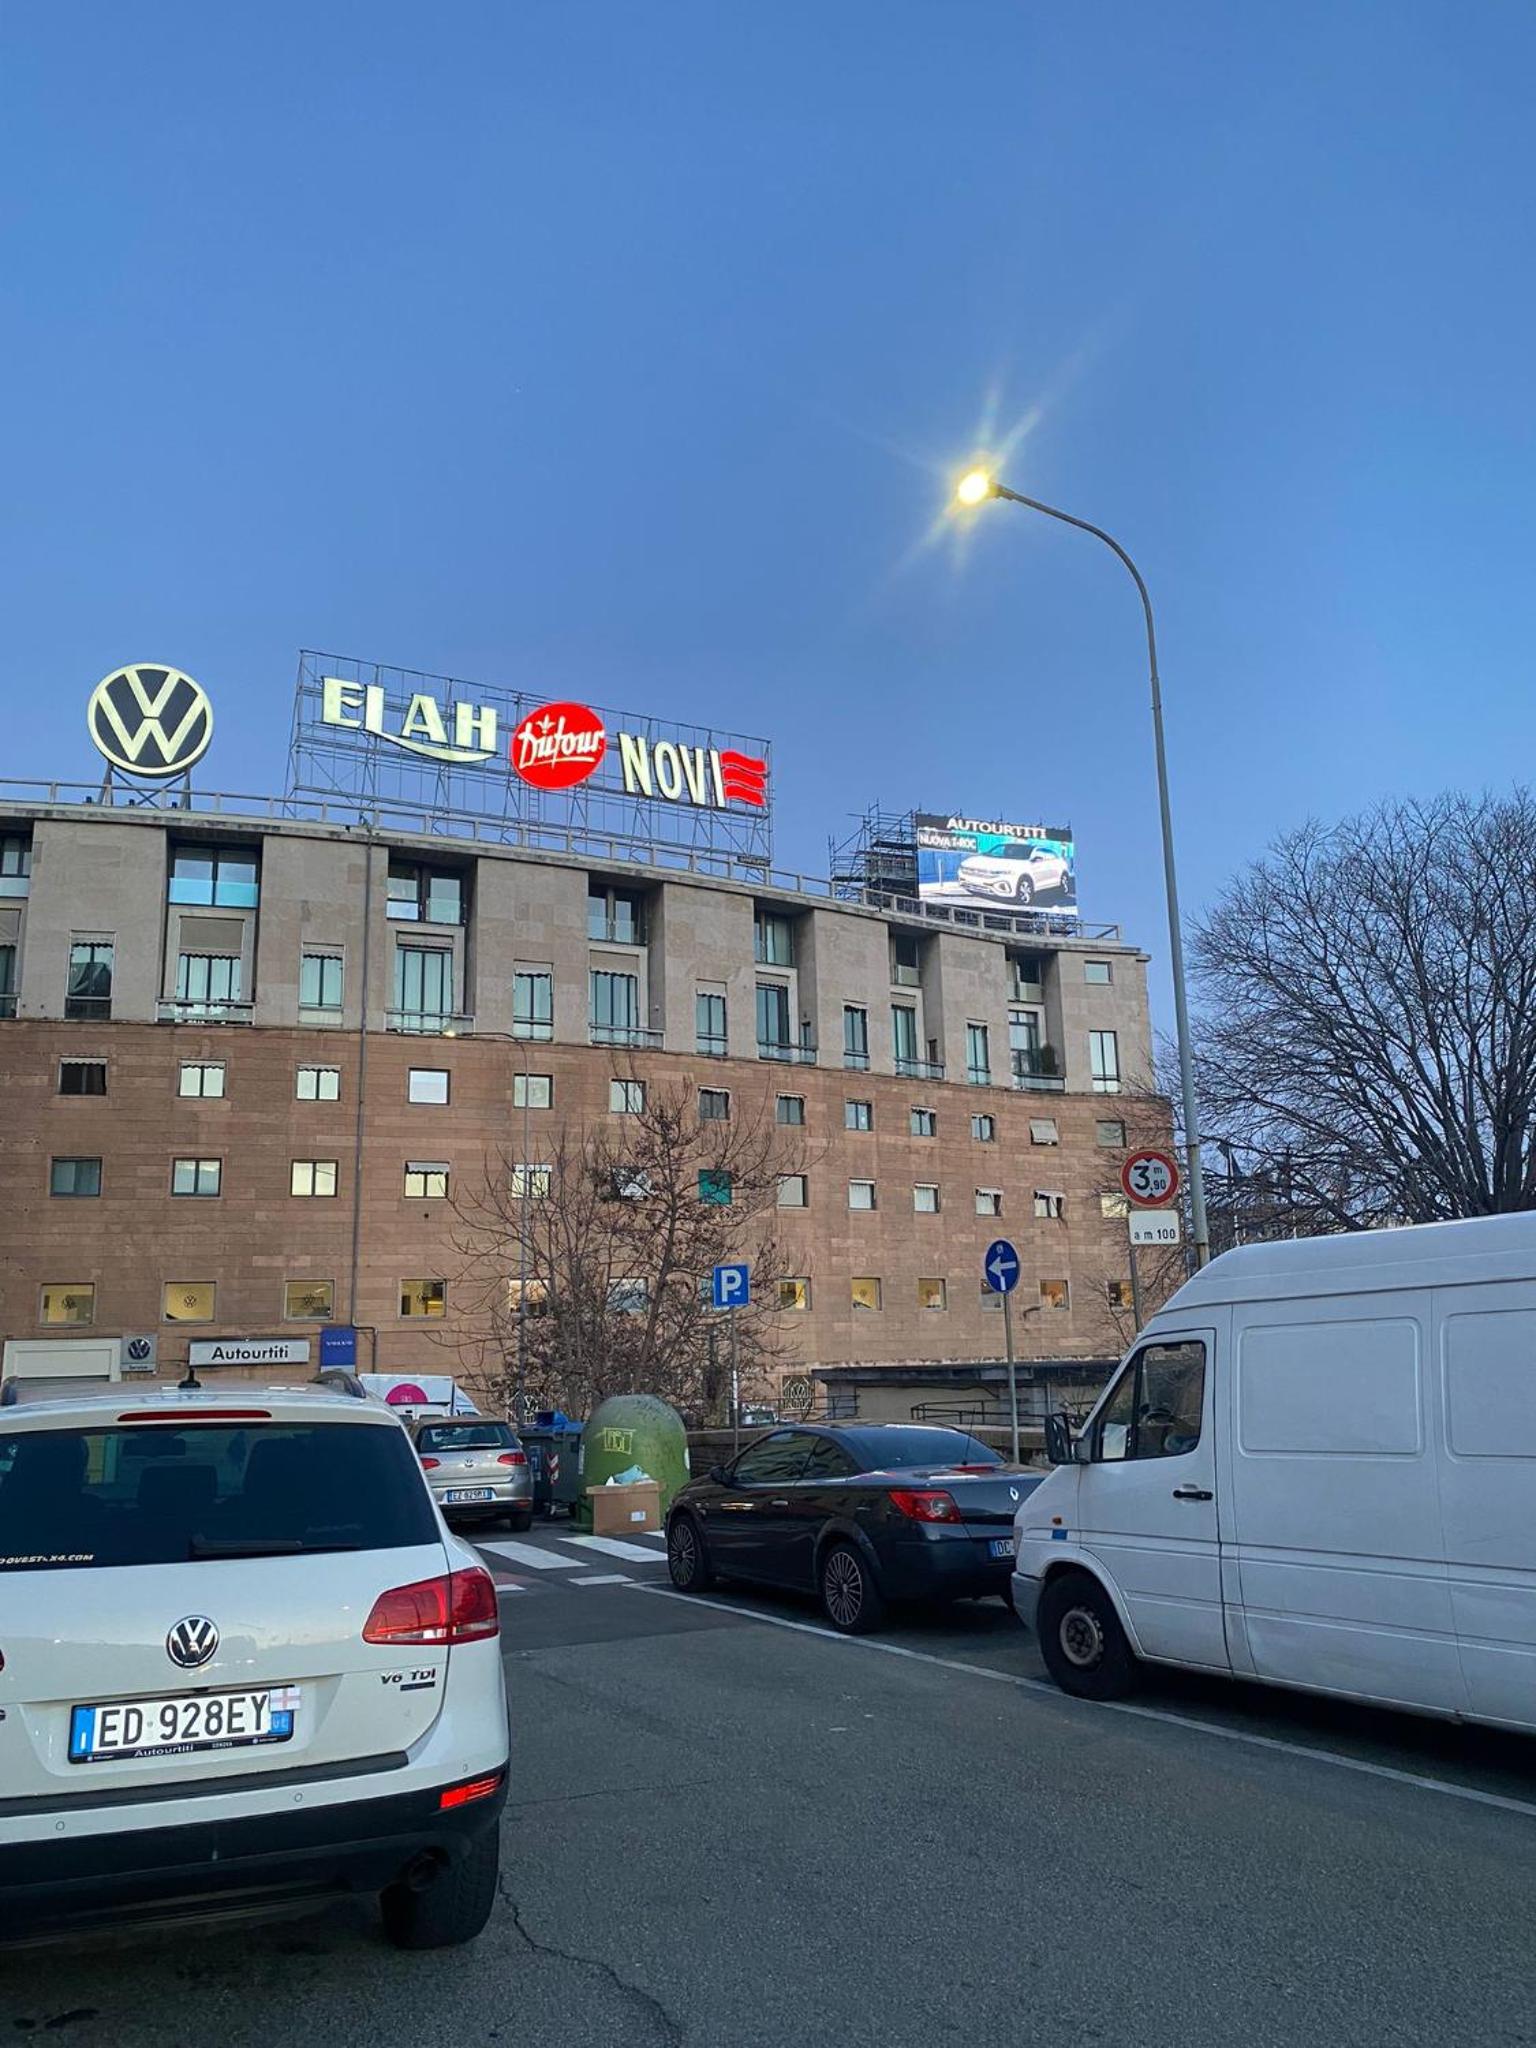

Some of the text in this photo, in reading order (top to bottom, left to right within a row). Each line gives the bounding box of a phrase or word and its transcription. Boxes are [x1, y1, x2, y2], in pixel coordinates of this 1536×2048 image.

[321, 676, 498, 763] ELAH
[518, 714, 605, 769] Dufour
[616, 731, 726, 808] NOVI
[946, 817, 1047, 839] AUTOURTITI
[919, 834, 950, 848] NUOVA
[1134, 1229, 1176, 1240] a m 100
[721, 1269, 742, 1302] P
[211, 1345, 289, 1361] Autourtiti
[381, 1668, 436, 1684] V6 TDI
[99, 1694, 268, 1748] ED 928EY
[134, 1744, 194, 1758] Autourtiti
